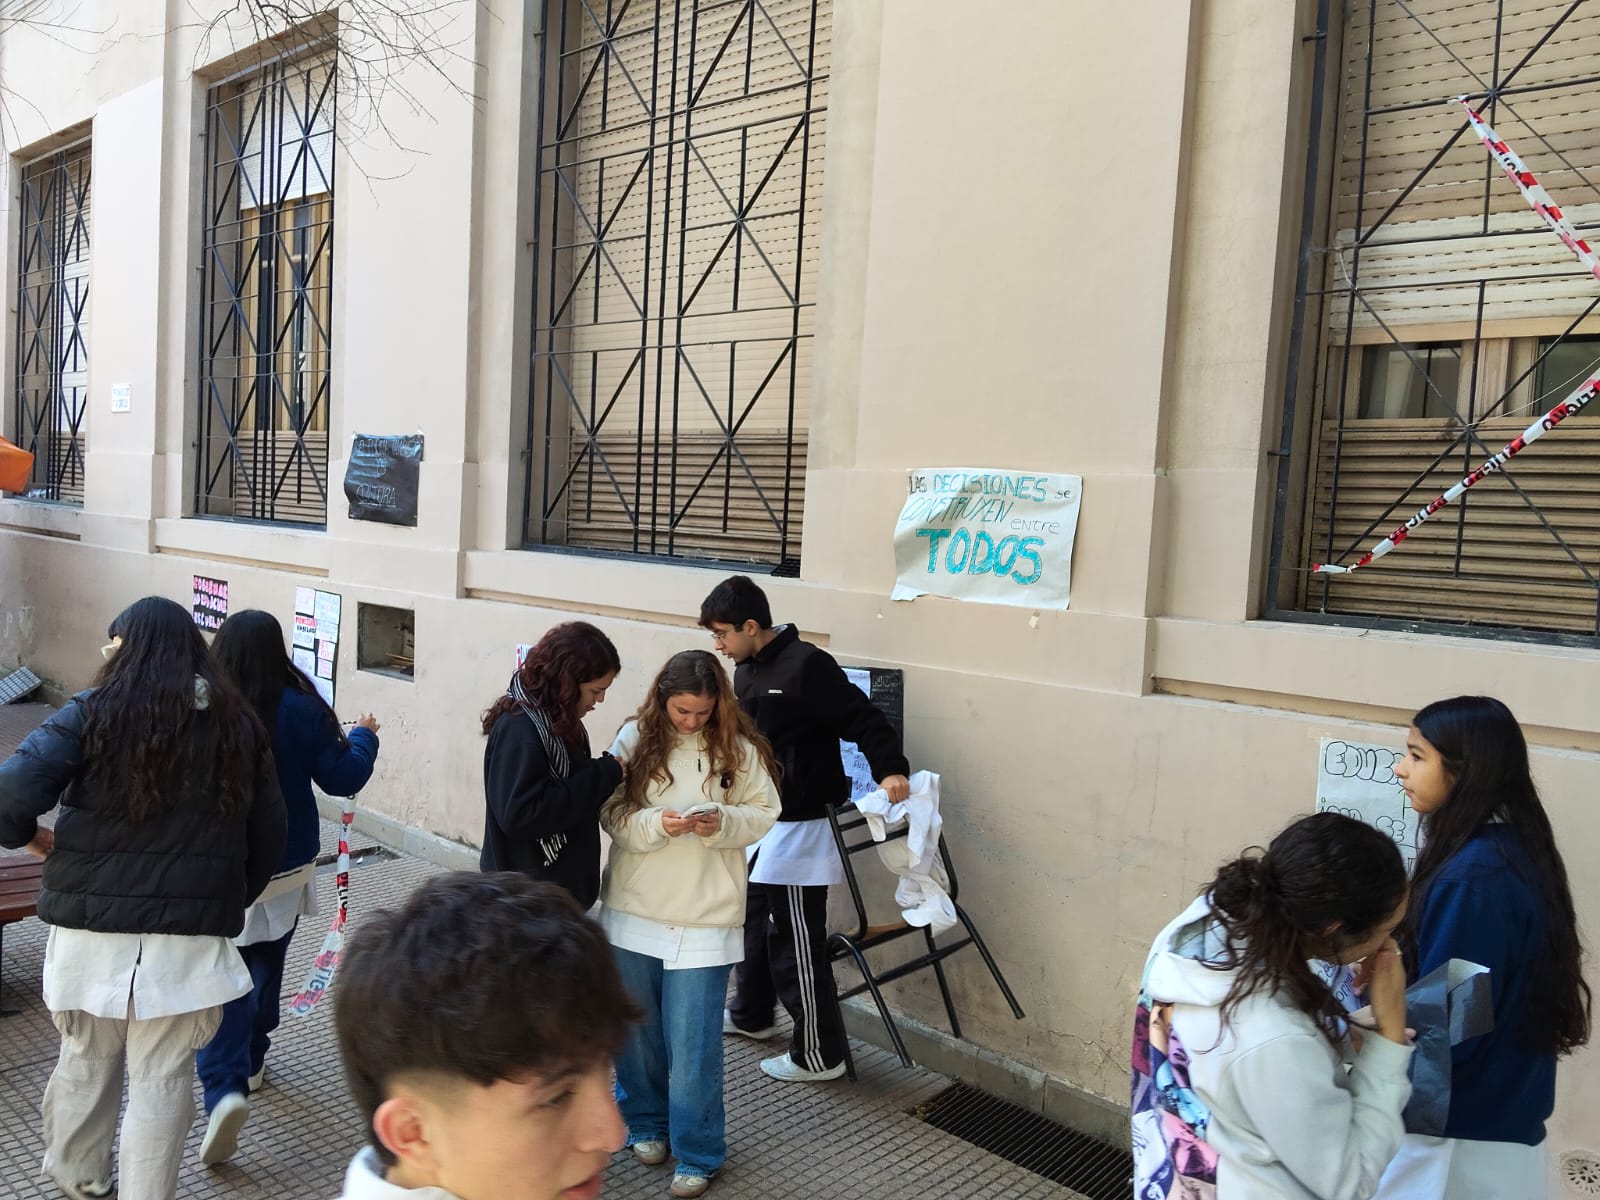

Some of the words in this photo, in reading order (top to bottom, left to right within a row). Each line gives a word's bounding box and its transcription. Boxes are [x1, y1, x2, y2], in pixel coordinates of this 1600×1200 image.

[933, 473, 1048, 502] DECISIONES
[1055, 489, 1072, 499] se
[901, 496, 1014, 524] CONSTRUYEN
[1010, 517, 1061, 534] entre
[915, 527, 1047, 585] TODOS
